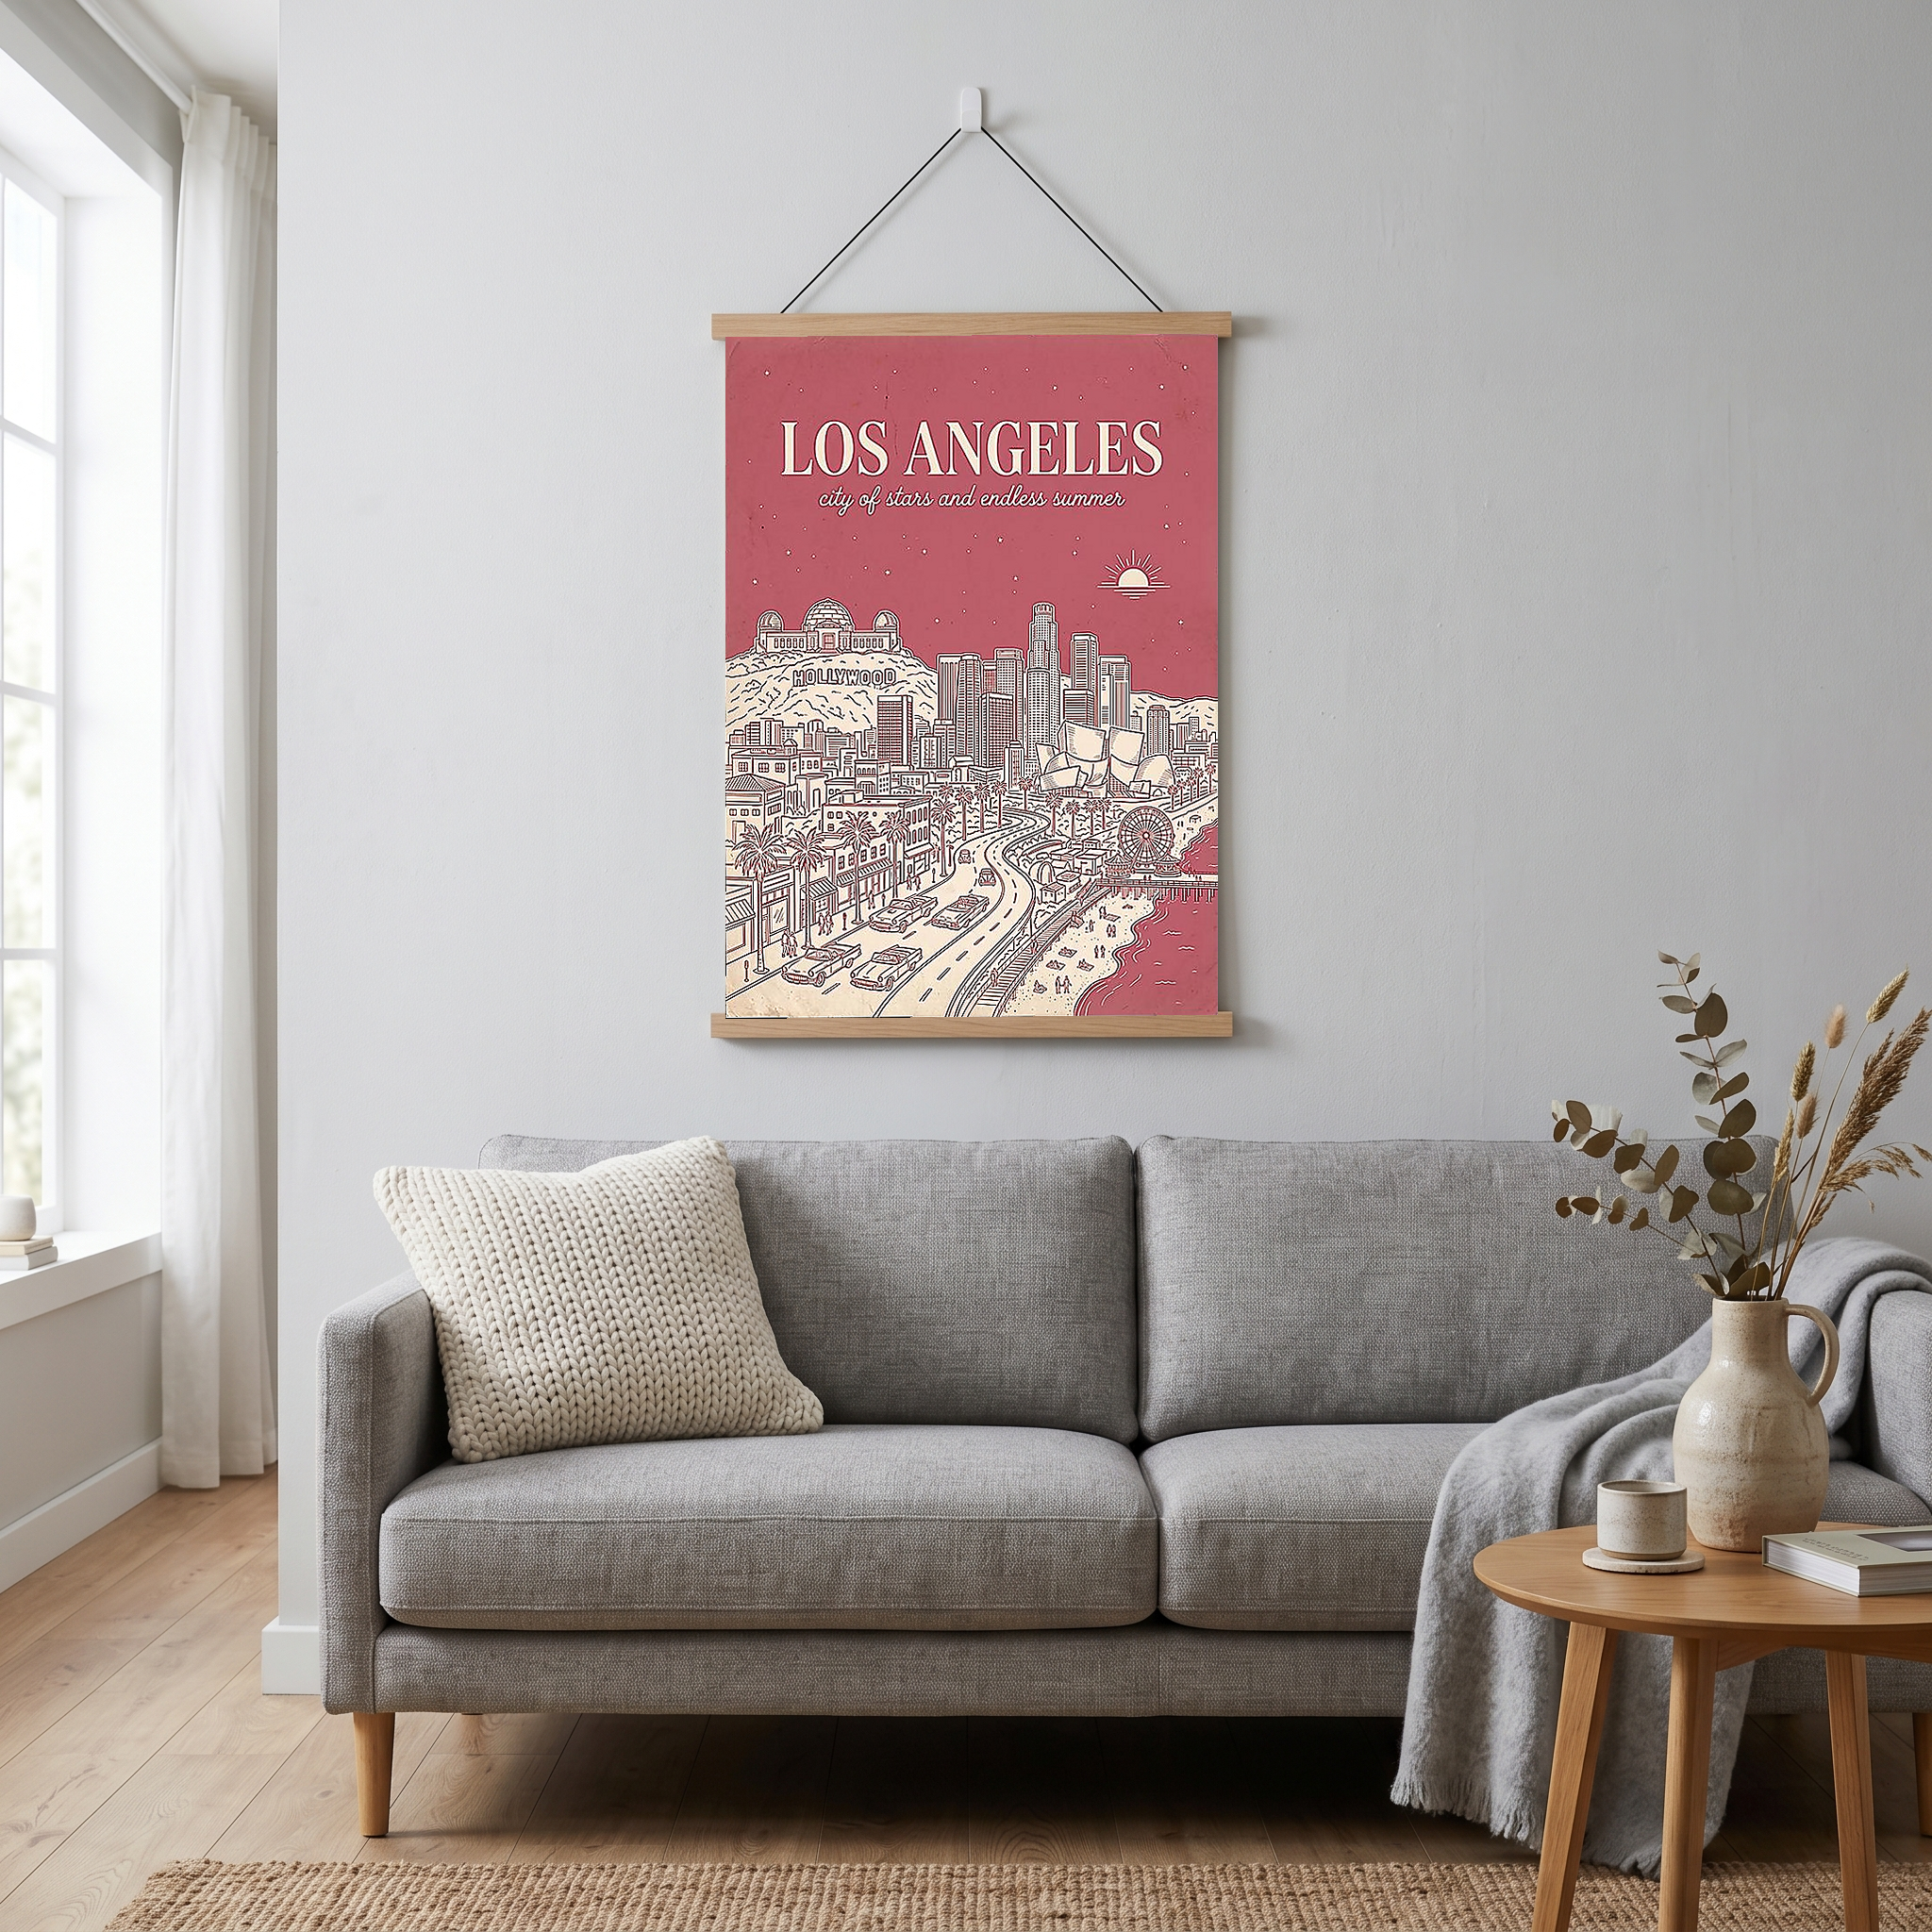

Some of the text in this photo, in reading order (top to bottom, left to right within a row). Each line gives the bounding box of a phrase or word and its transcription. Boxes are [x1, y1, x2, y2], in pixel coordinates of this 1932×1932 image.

[781, 420, 1163, 476] LOS ANGELES
[819, 484, 1125, 516] city of stars and endless summer
[792, 668, 896, 687] HOLLYWOOD
